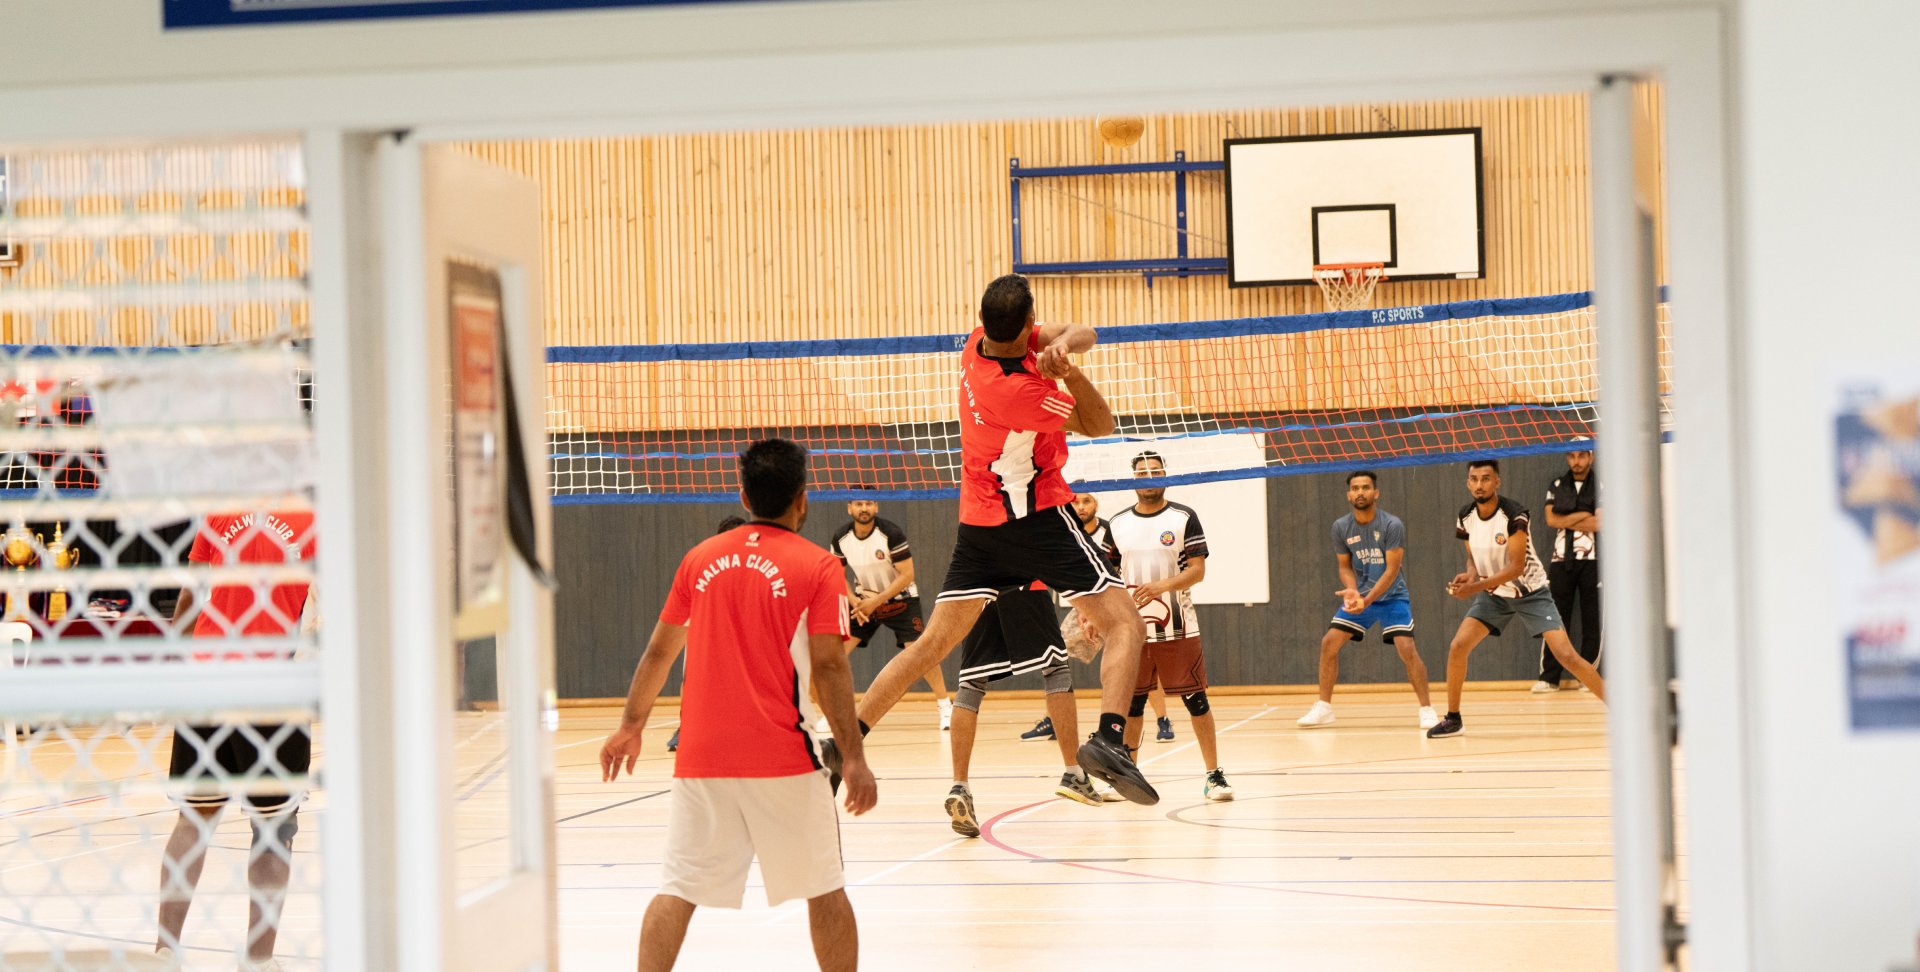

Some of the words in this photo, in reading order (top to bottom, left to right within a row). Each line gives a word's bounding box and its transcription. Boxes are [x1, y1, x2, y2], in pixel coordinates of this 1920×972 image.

[1372, 310, 1386, 324] P.C
[1387, 306, 1424, 322] SPORTS
[220, 513, 256, 545] MALW
[264, 515, 295, 541] CLUB
[695, 553, 741, 593] MALWA
[745, 553, 780, 580] CLUB
[770, 577, 788, 599] NZ
